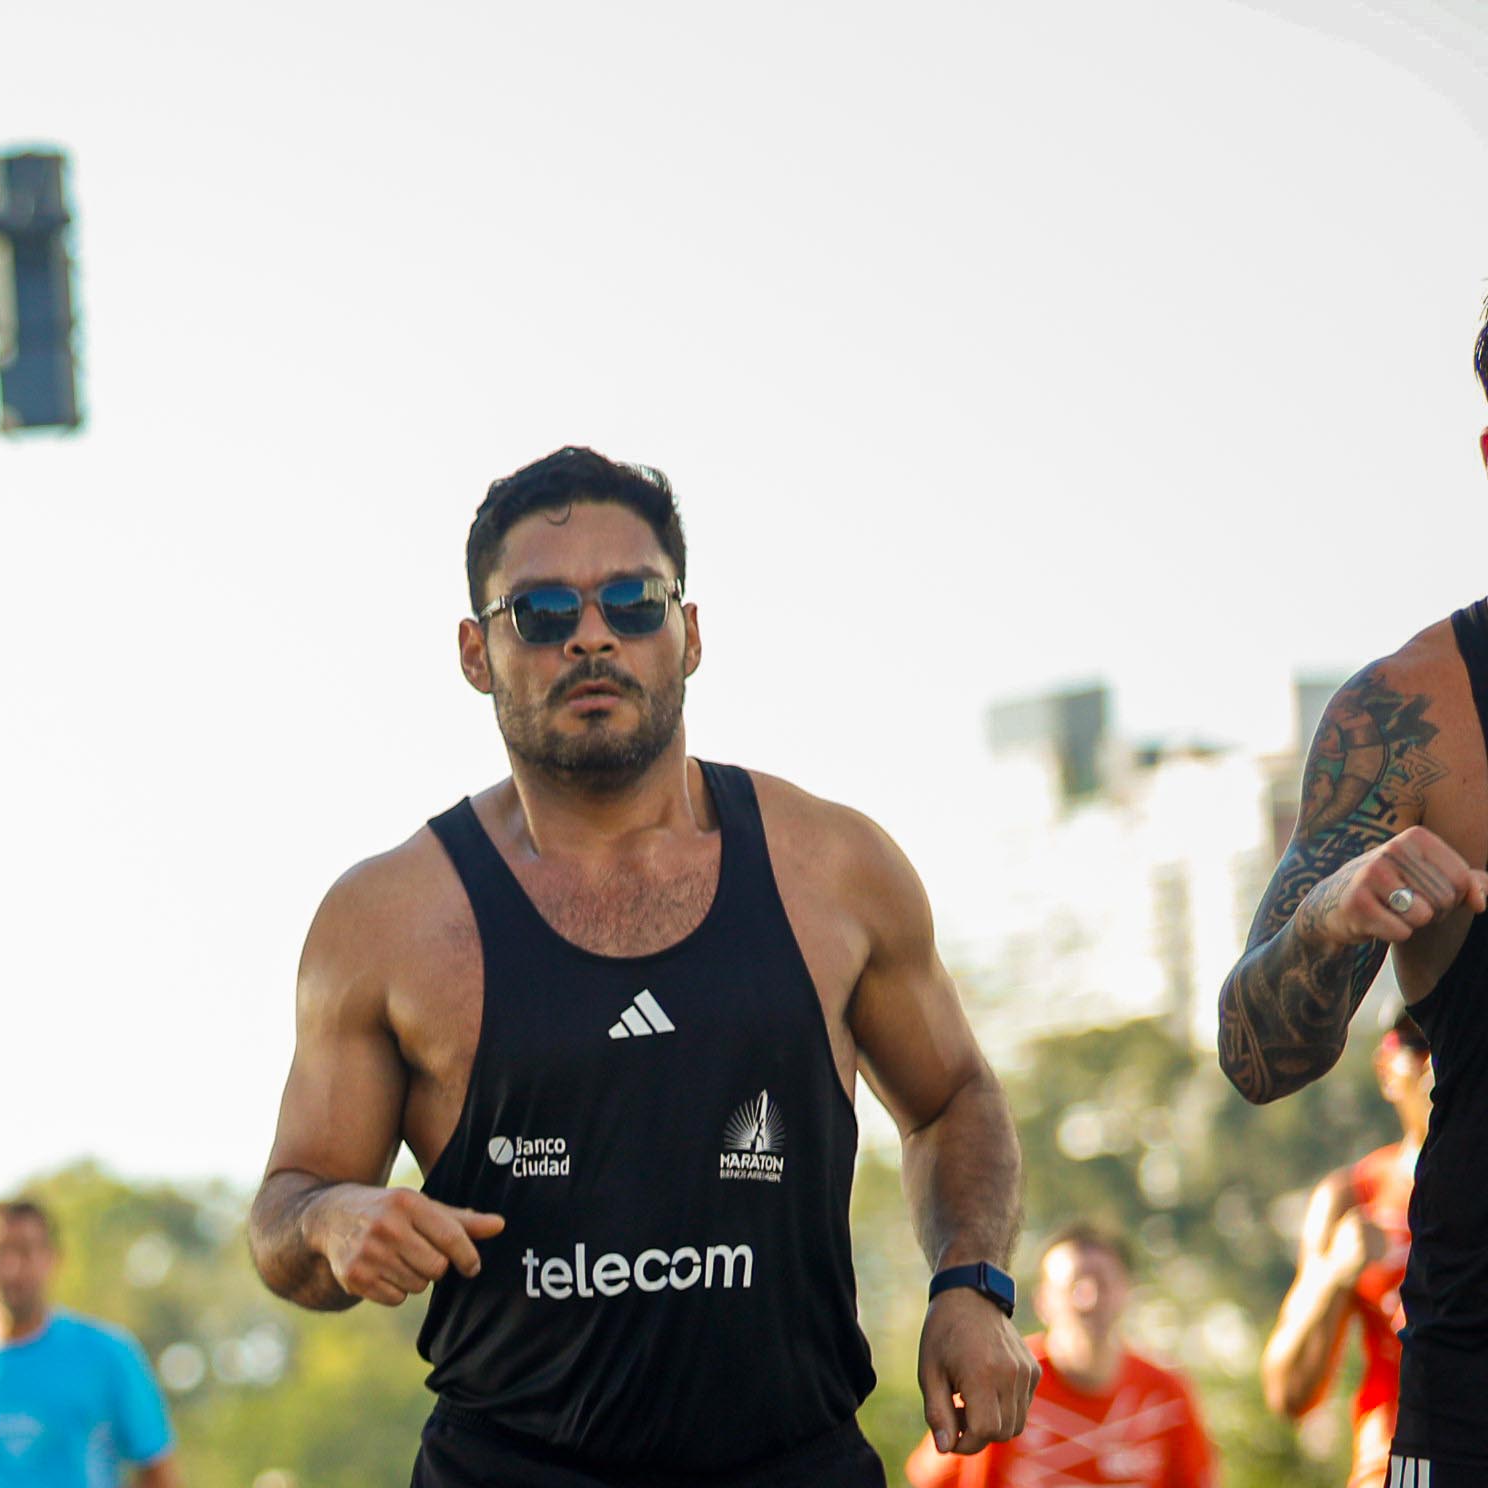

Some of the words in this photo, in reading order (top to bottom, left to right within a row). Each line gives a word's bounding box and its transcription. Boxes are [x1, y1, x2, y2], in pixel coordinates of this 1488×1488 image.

[512, 1154, 571, 1177] Ciudad
[719, 1152, 784, 1172] MARATON
[522, 1242, 754, 1300] telecom
